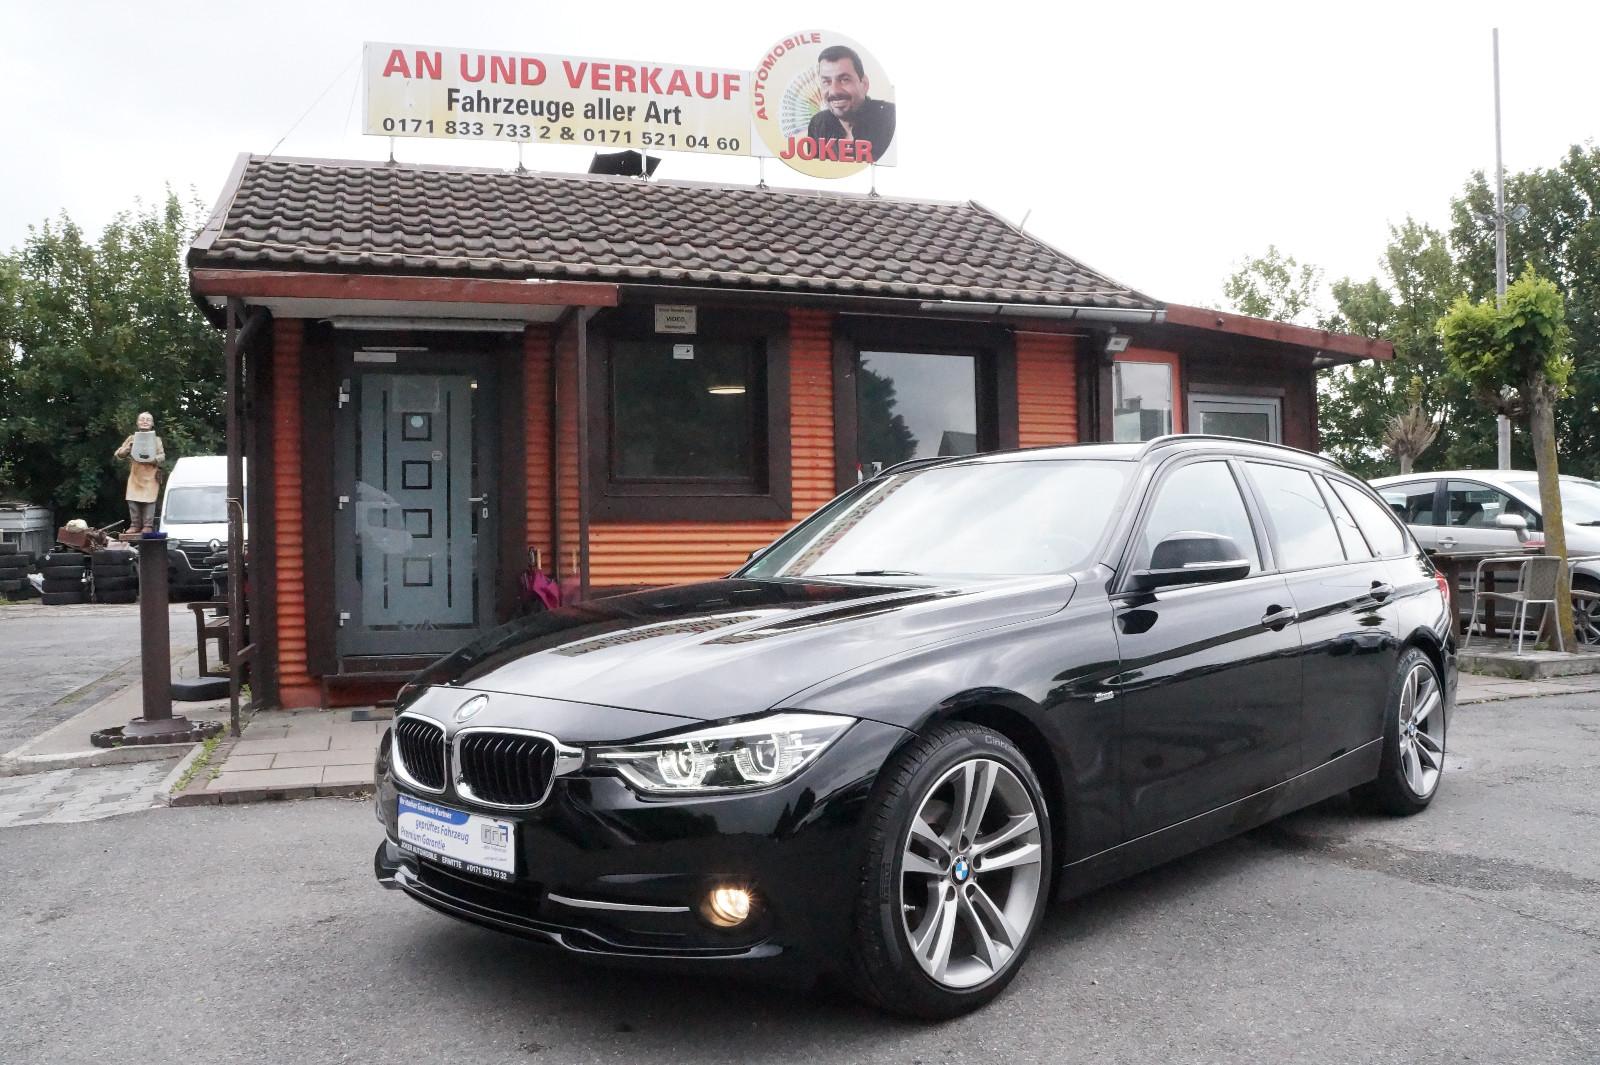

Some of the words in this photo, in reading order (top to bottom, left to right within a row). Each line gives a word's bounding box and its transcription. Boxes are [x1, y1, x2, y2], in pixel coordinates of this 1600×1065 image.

[383, 49, 442, 80] AN
[460, 53, 547, 86] UND
[562, 60, 740, 101] VERKAUF
[754, 33, 822, 120] AUTOMOBILE
[447, 88, 574, 123] Fahrzeuge
[584, 97, 636, 122] aller
[644, 101, 682, 125] Art
[383, 117, 434, 133] 0171
[445, 121, 484, 135] 833
[493, 123, 531, 138] 733
[540, 125, 551, 140] 2
[560, 126, 575, 141] &
[584, 128, 631, 143] 0171
[642, 132, 676, 147] 521
[686, 135, 709, 149] 04
[717, 137, 740, 151] 60
[780, 136, 874, 164] JOKER
[422, 833, 446, 850] Garantie
[440, 825, 469, 845] Fahrzeug
